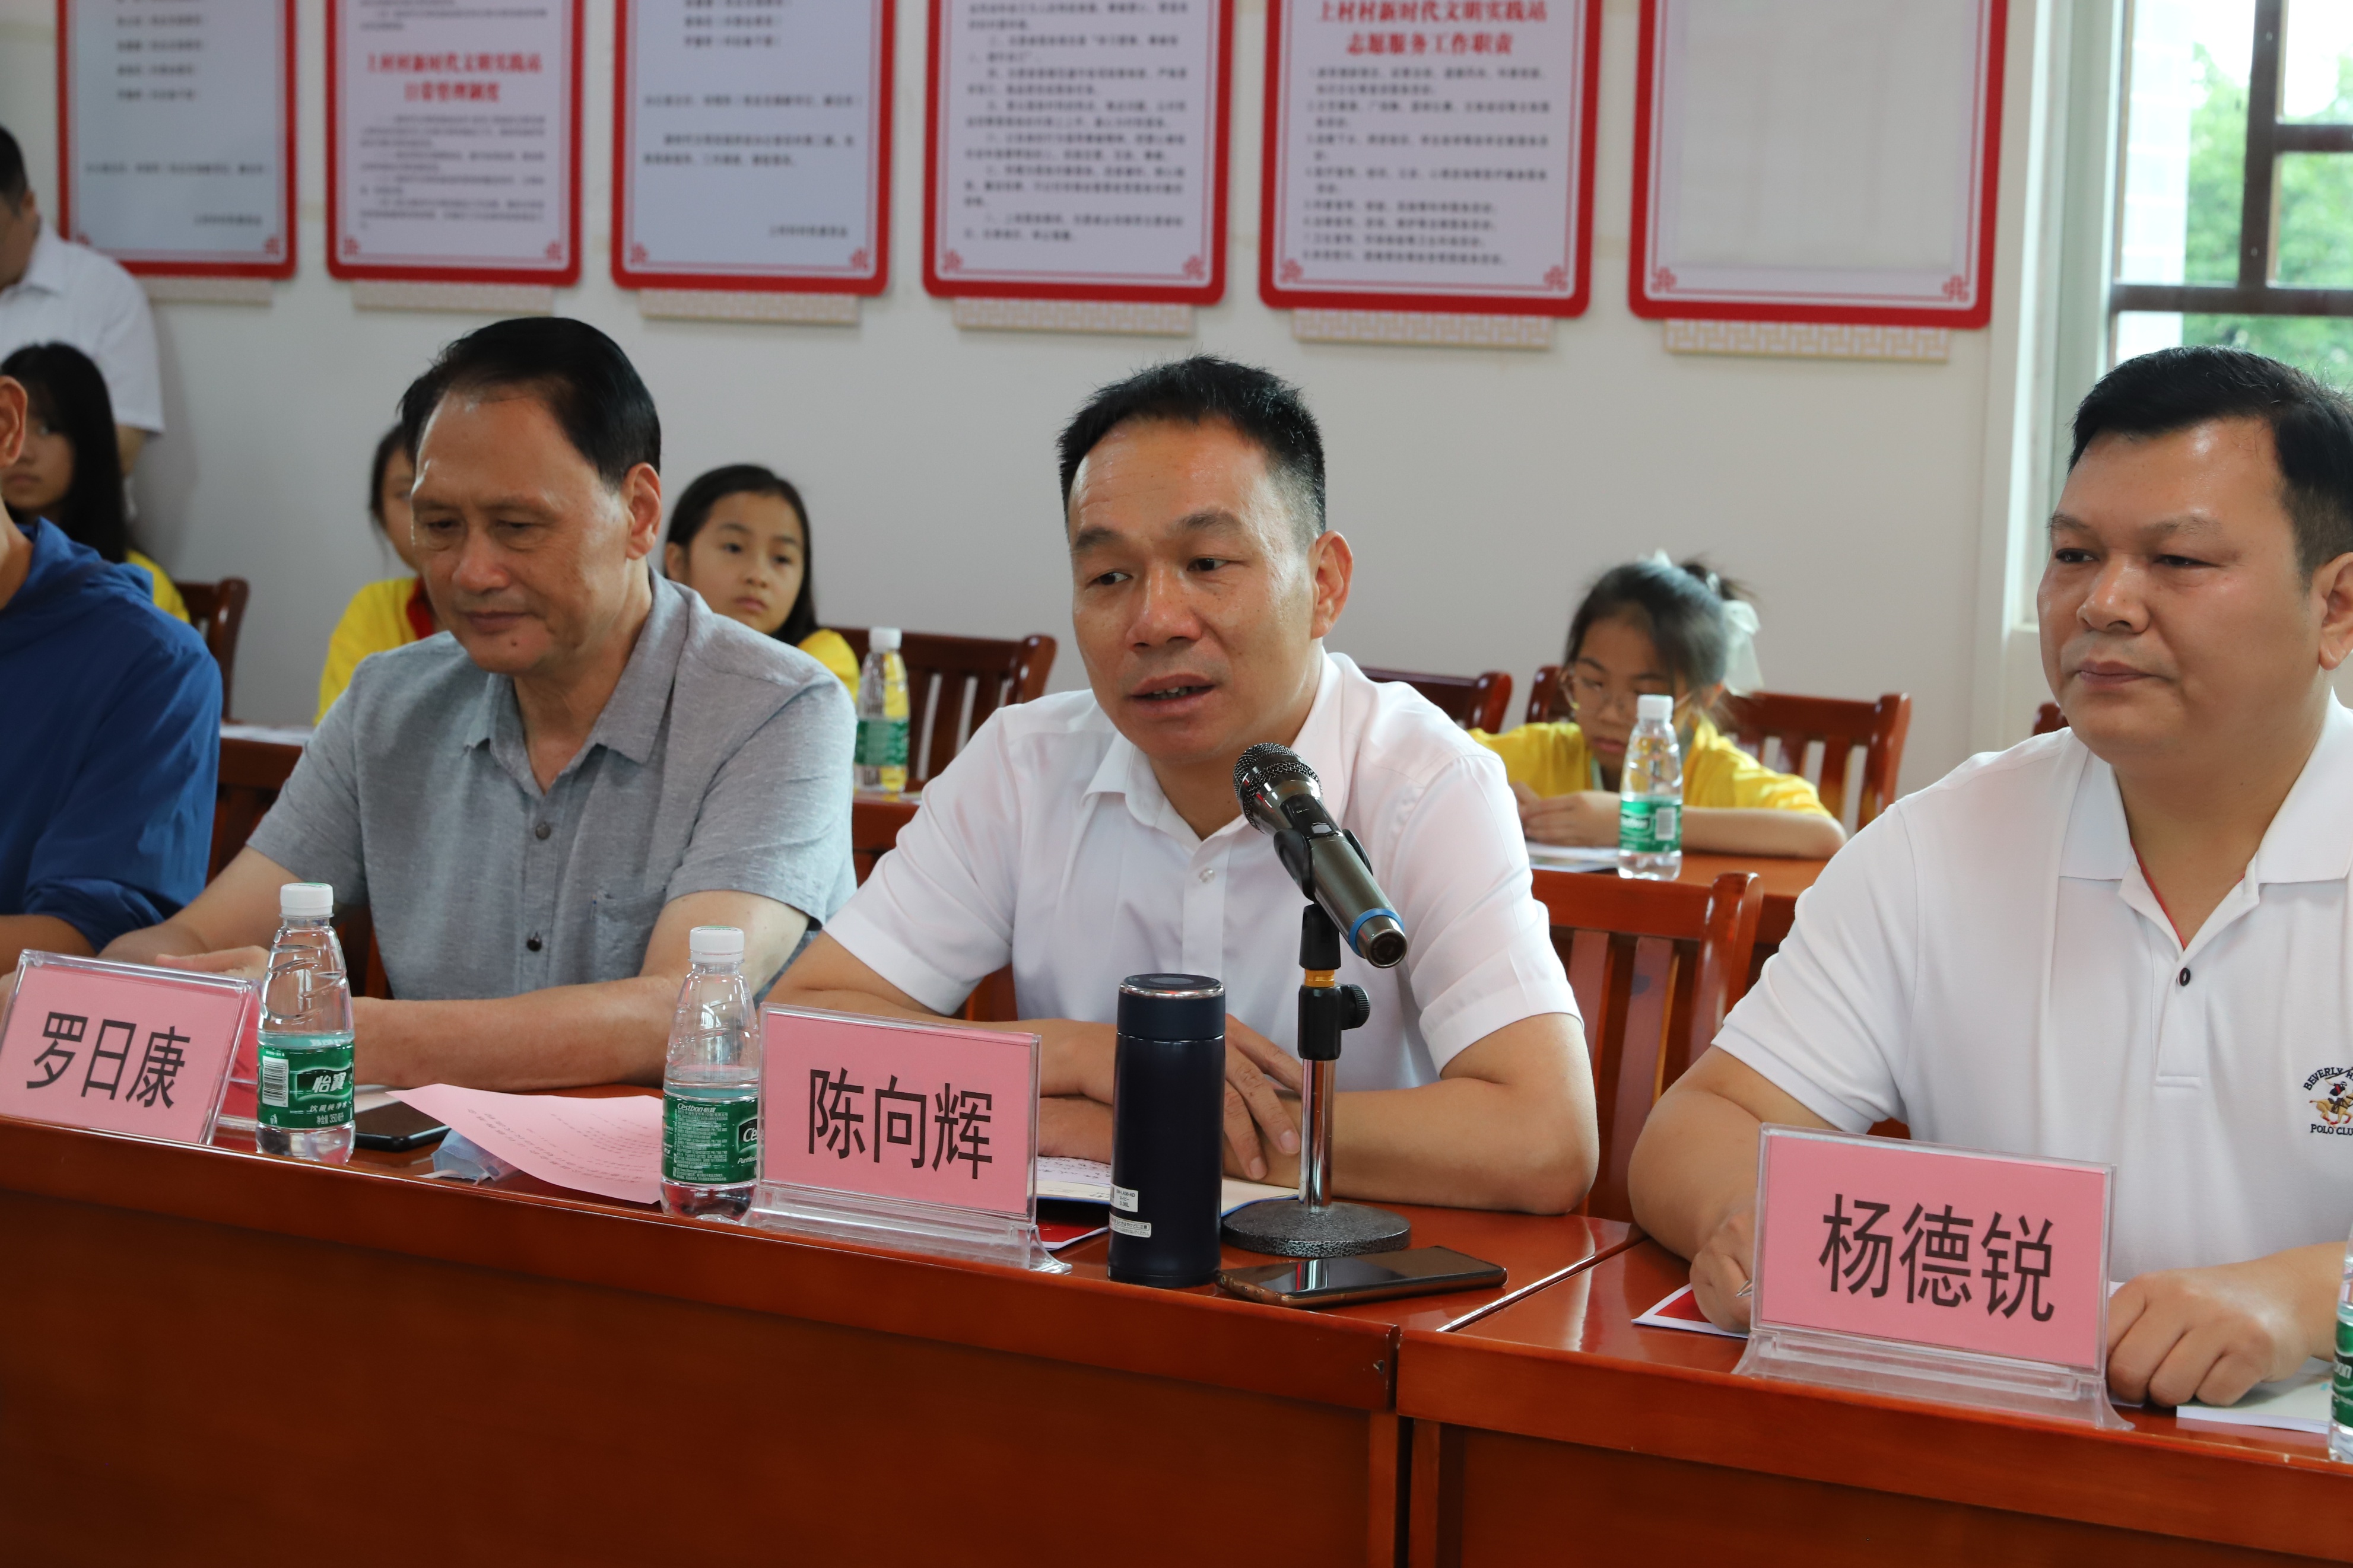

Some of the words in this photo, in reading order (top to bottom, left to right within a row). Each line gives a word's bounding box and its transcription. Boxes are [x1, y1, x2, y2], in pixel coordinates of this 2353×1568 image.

[1319, 0, 1548, 22] 上村村新时代文明实践站
[1347, 31, 1514, 56] 志愿服务工作职责
[27, 1011, 191, 1110] 罗日康
[312, 1072, 347, 1093] 怡寶
[2303, 1067, 2344, 1090] BEVERLY
[808, 1067, 993, 1180] 陈向辉
[2310, 1124, 2334, 1134] POLO
[1818, 1192, 2055, 1322] 杨德锐
